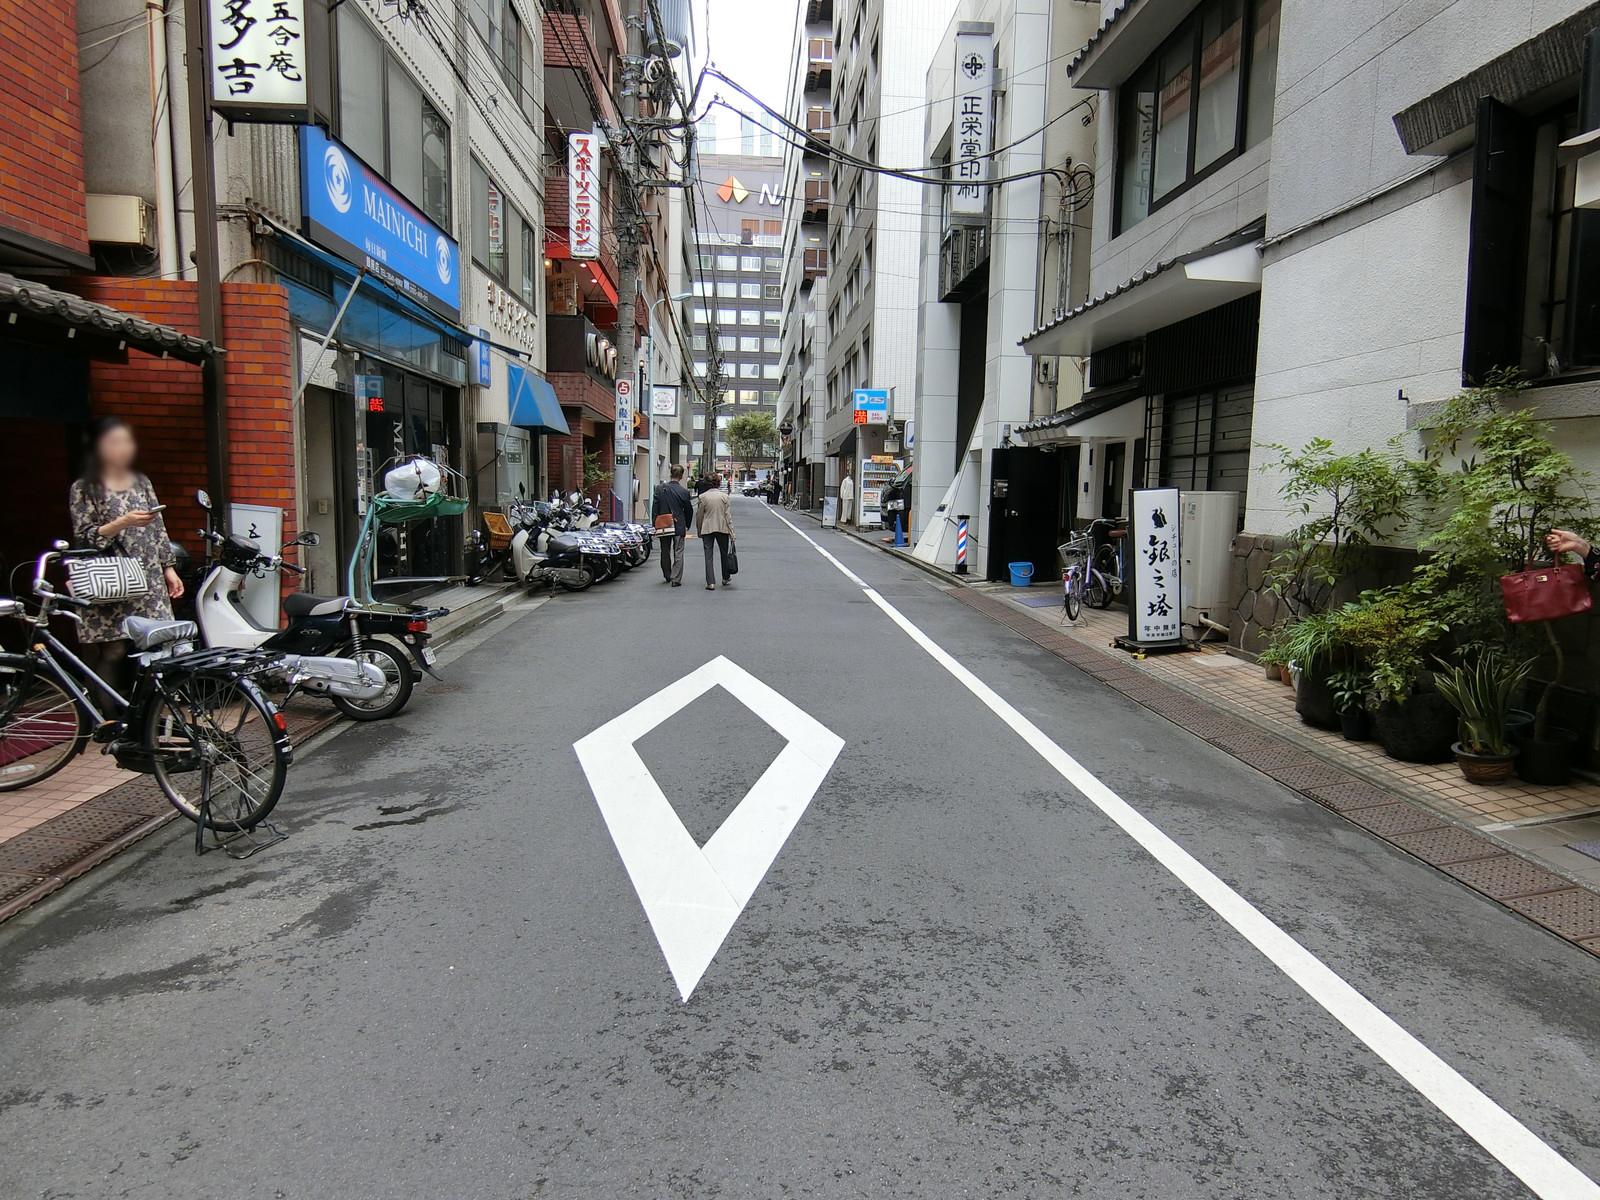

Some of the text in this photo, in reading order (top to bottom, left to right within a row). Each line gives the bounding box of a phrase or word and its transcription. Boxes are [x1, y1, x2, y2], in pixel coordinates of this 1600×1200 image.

[266, 1, 302, 82] 五合庵
[957, 96, 984, 199] 正栄堂印刷
[363, 183, 429, 259] MAINICHI
[573, 139, 594, 246] スポーツニッポン
[854, 410, 868, 424] 満
[856, 393, 868, 411] P
[1170, 524, 1179, 578] シチューの店
[1143, 623, 1177, 632] 年中無休
